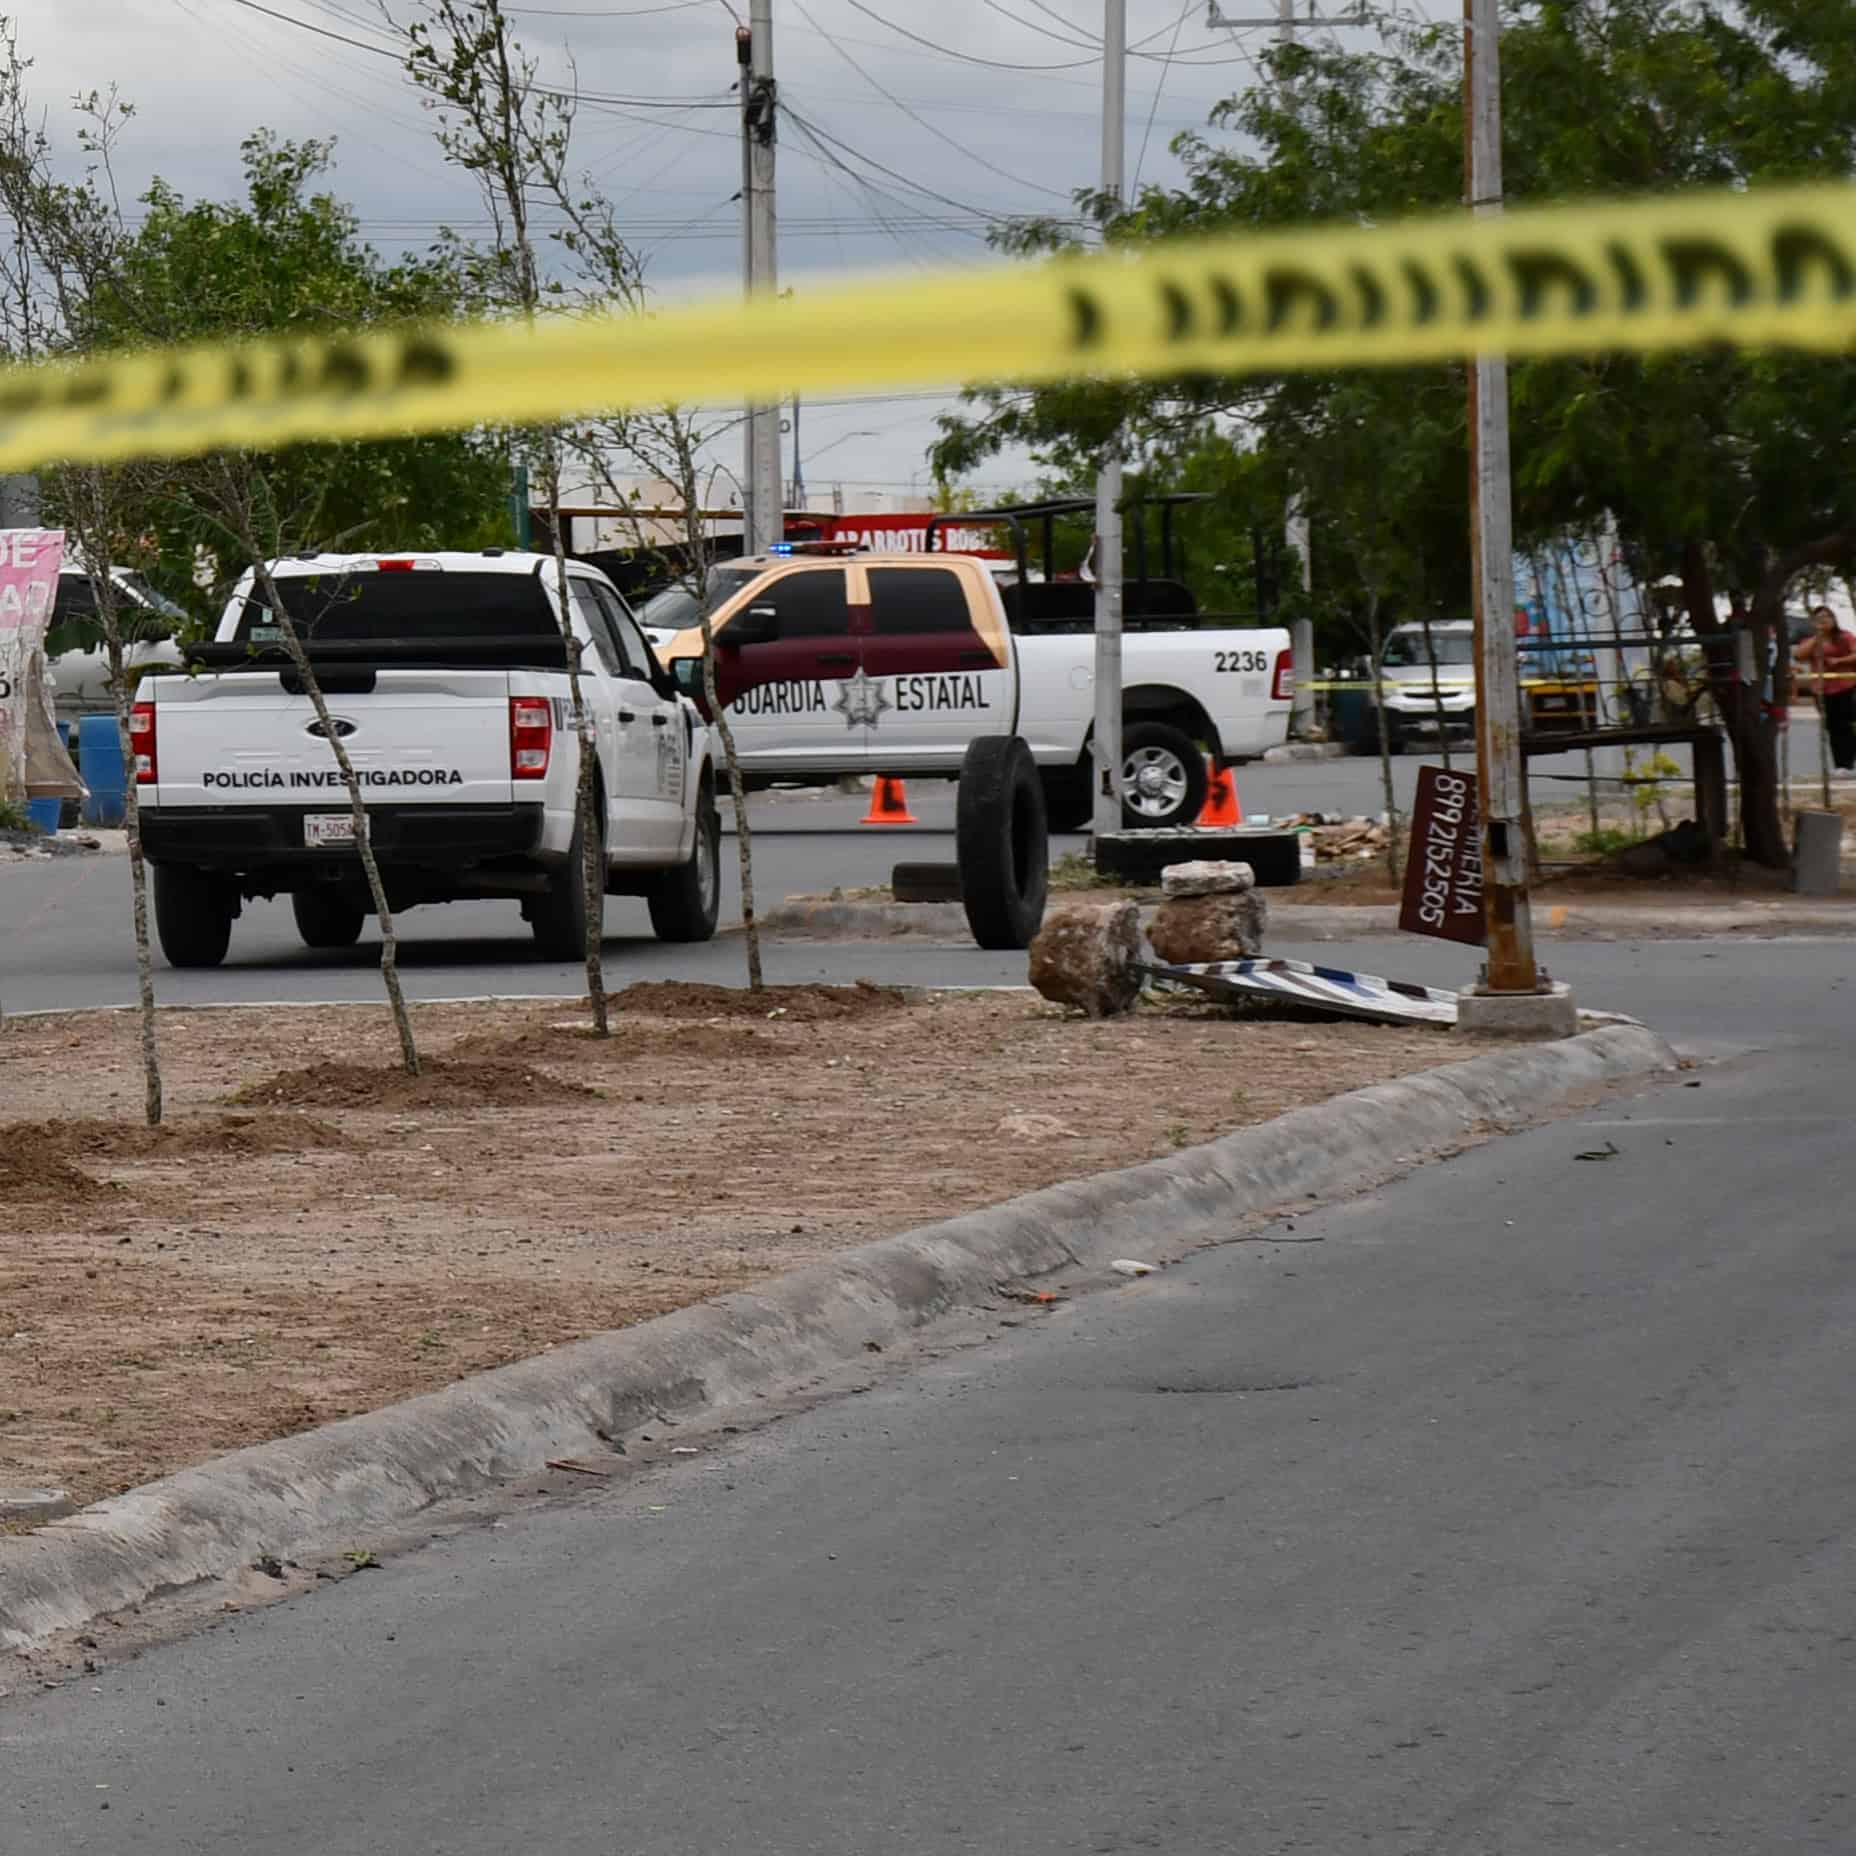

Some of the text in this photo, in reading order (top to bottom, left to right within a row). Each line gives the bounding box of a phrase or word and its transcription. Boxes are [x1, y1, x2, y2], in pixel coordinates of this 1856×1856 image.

[1214, 650, 1267, 673] 2236
[895, 675, 991, 712] ESTATAL
[202, 767, 464, 789] POLICÍA INVESTIGADORA
